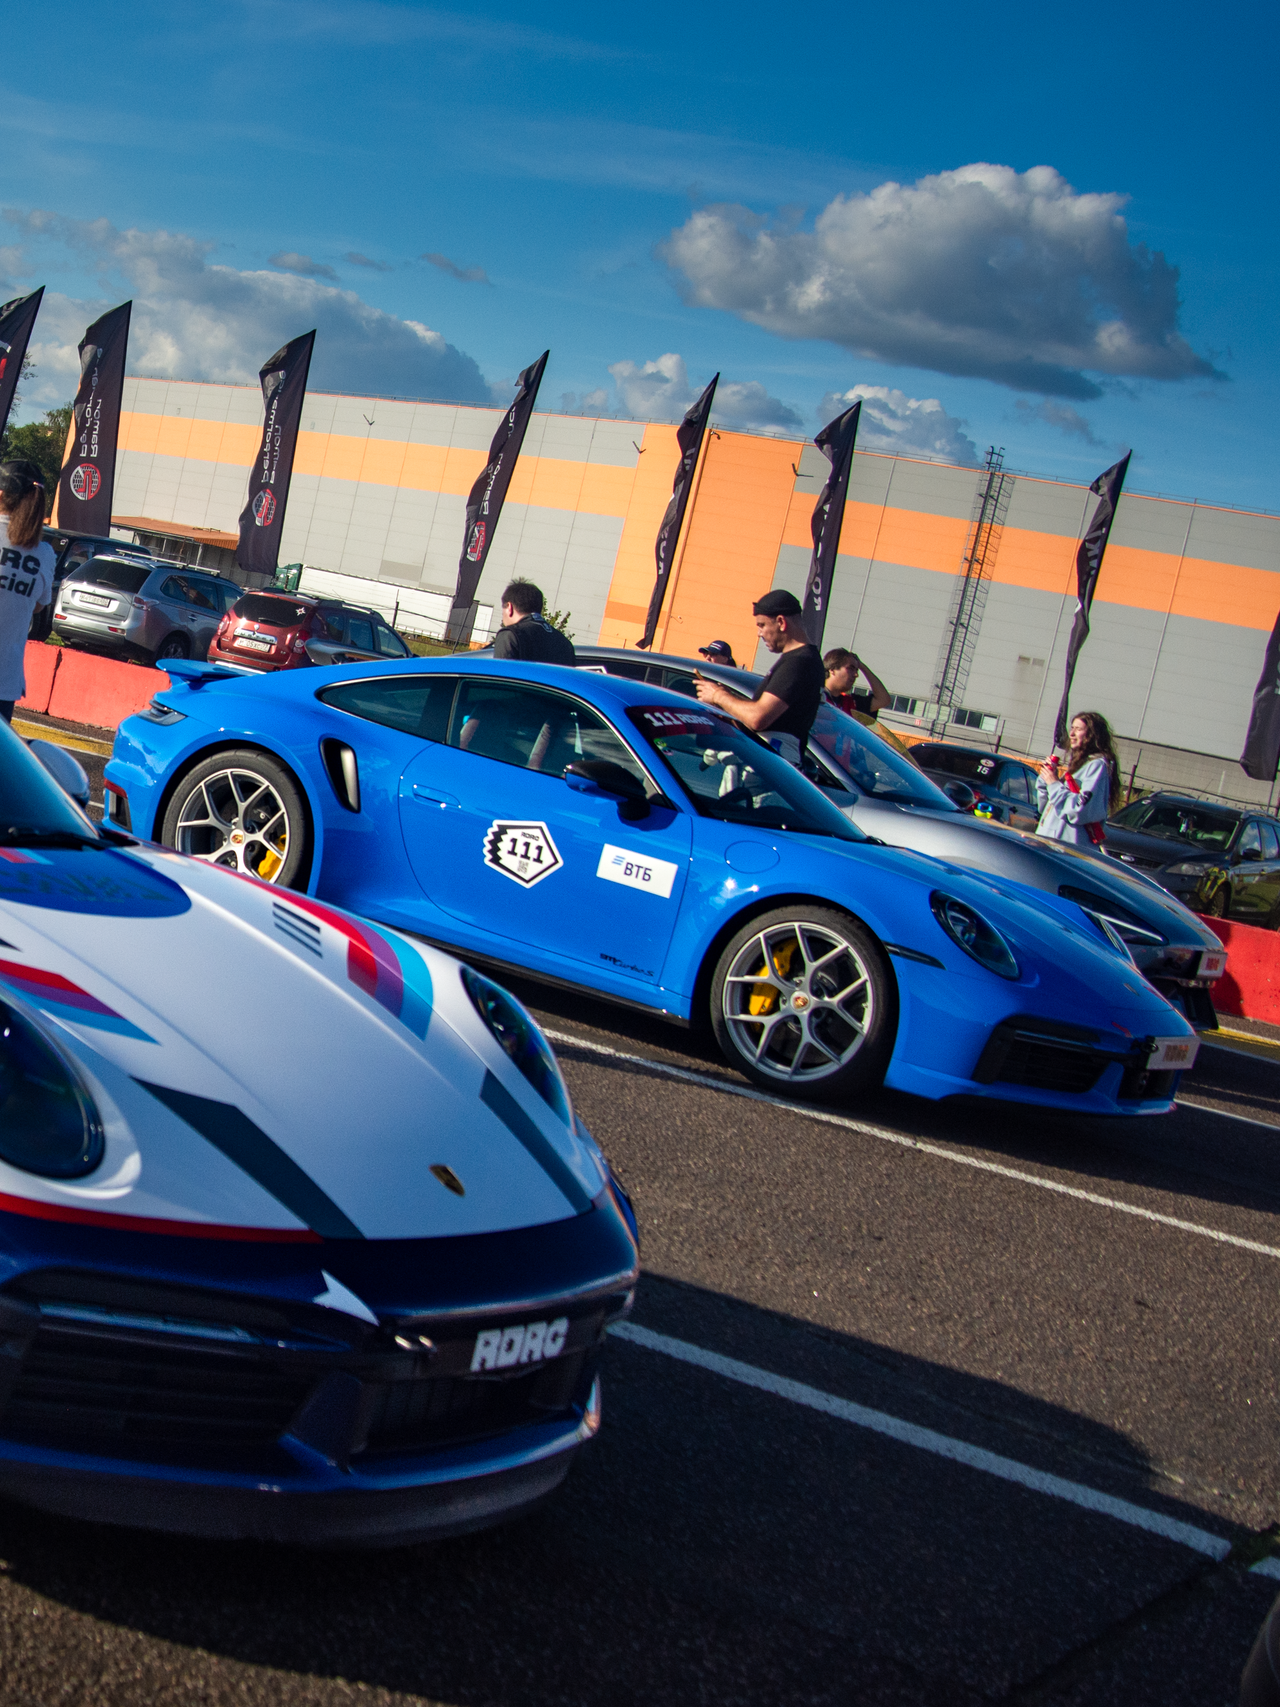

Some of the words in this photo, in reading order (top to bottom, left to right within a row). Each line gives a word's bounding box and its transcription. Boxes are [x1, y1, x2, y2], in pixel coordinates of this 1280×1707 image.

[643, 712, 683, 727] 111
[976, 765, 990, 775] 15
[507, 837, 544, 864] 111
[623, 862, 653, 882] ВТБ
[469, 1316, 569, 1373] RDRC
